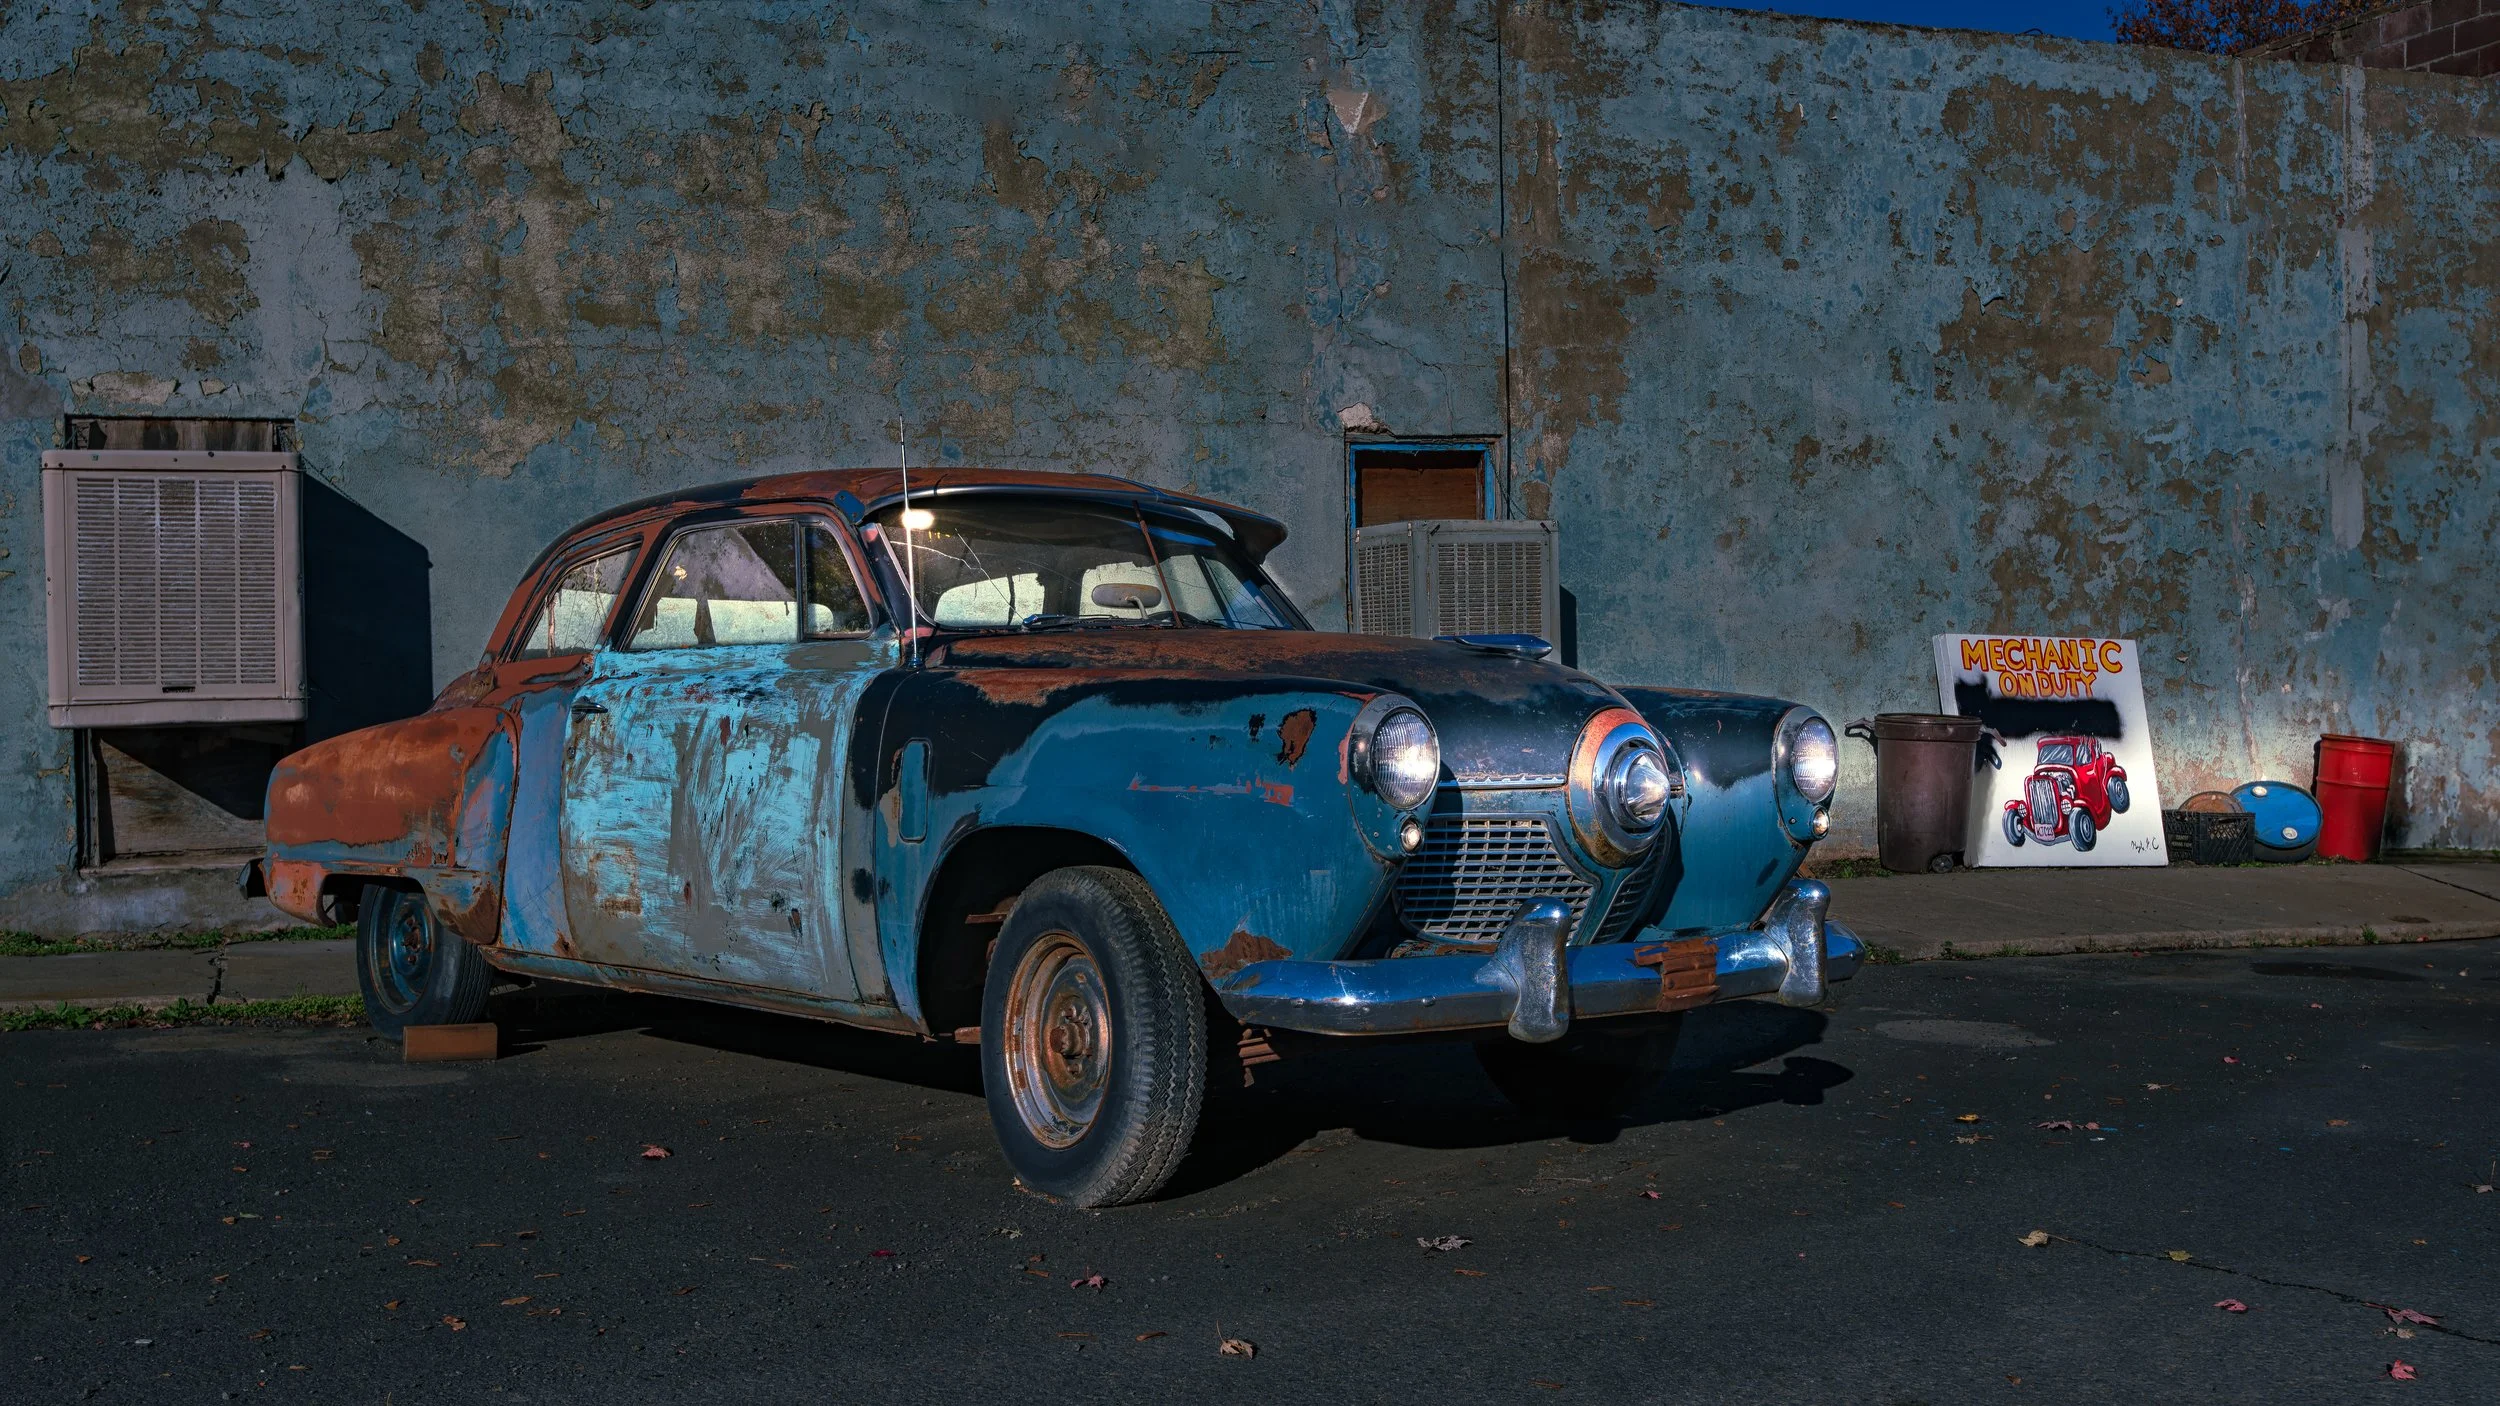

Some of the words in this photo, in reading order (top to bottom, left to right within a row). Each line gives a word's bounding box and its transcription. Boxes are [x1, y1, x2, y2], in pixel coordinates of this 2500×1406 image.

[1961, 639, 2123, 673] MECHANIC
[1999, 670, 2038, 698] ON
[2035, 670, 2097, 699] DUTY
